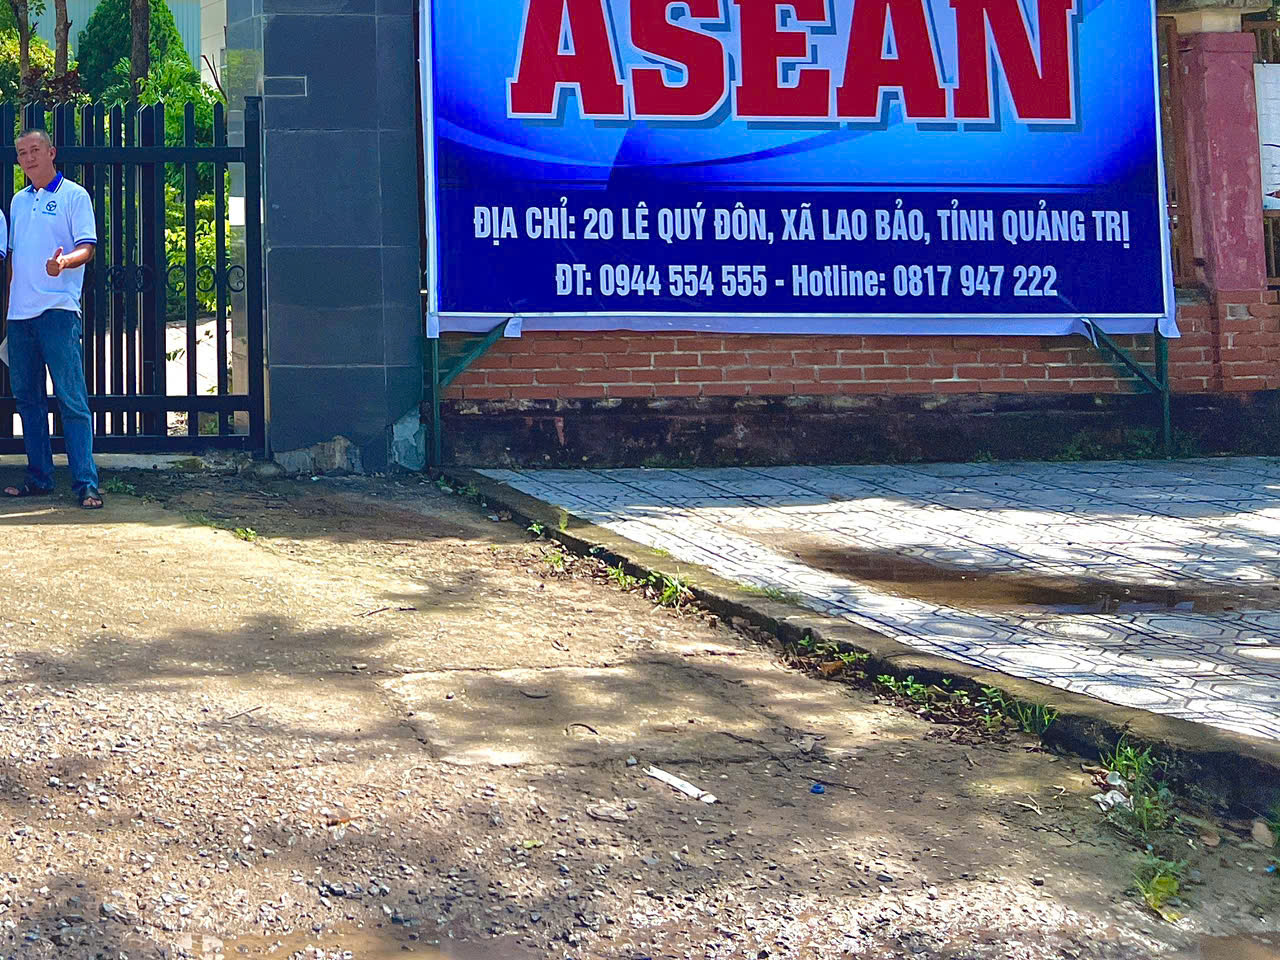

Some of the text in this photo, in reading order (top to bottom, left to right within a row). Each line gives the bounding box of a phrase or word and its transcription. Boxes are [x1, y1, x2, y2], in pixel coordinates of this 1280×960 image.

[473, 196, 1131, 250] ĐỊA CHỈ: 20 LÊ QUÝ ĐÔN, XÃ LAO BẢO, TỈNH QUẢNG TRỊ
[555, 265, 591, 297] ĐT:
[598, 265, 661, 297] 0944
[667, 265, 714, 297] 554
[721, 265, 767, 297] 555
[791, 265, 886, 298] Hotline:
[893, 265, 953, 298] 0817
[960, 265, 1003, 298] 947
[1013, 265, 1058, 298] 222
